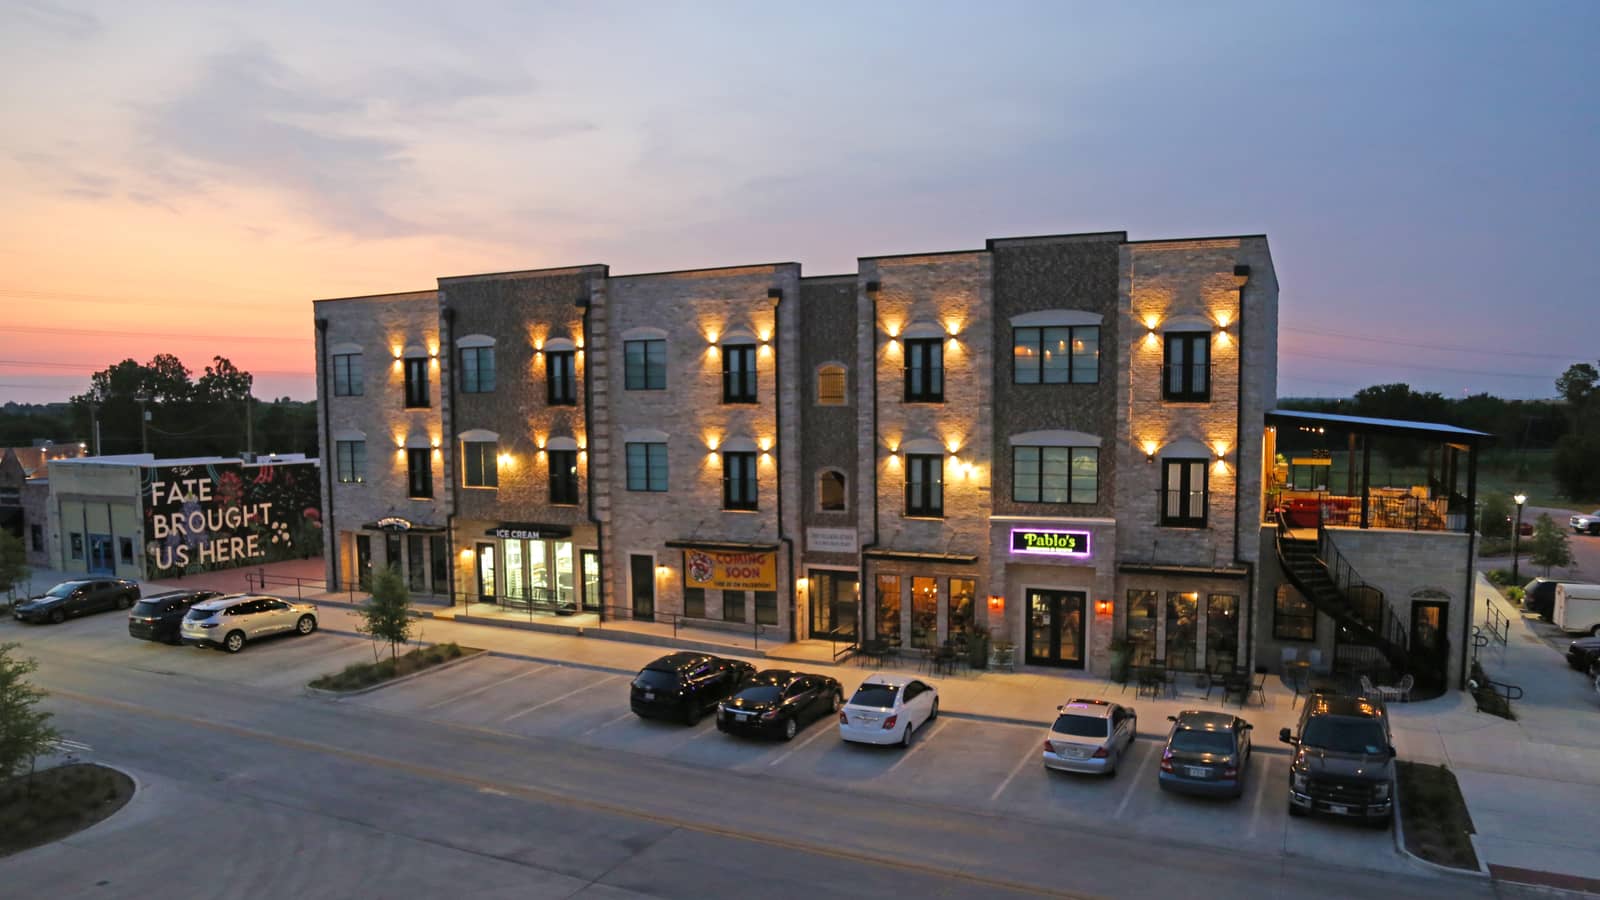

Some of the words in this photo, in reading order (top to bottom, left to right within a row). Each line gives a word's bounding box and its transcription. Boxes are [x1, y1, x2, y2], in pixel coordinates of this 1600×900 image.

[151, 478, 213, 506] FATE
[153, 502, 273, 539] BROUGHT
[496, 529, 510, 538] ICE
[511, 529, 540, 539] CREAM
[1023, 533, 1076, 548] Pablo's
[154, 545, 190, 570] US
[200, 534, 266, 565] HERE.
[716, 553, 766, 566] COMING
[726, 567, 760, 578] SOON
